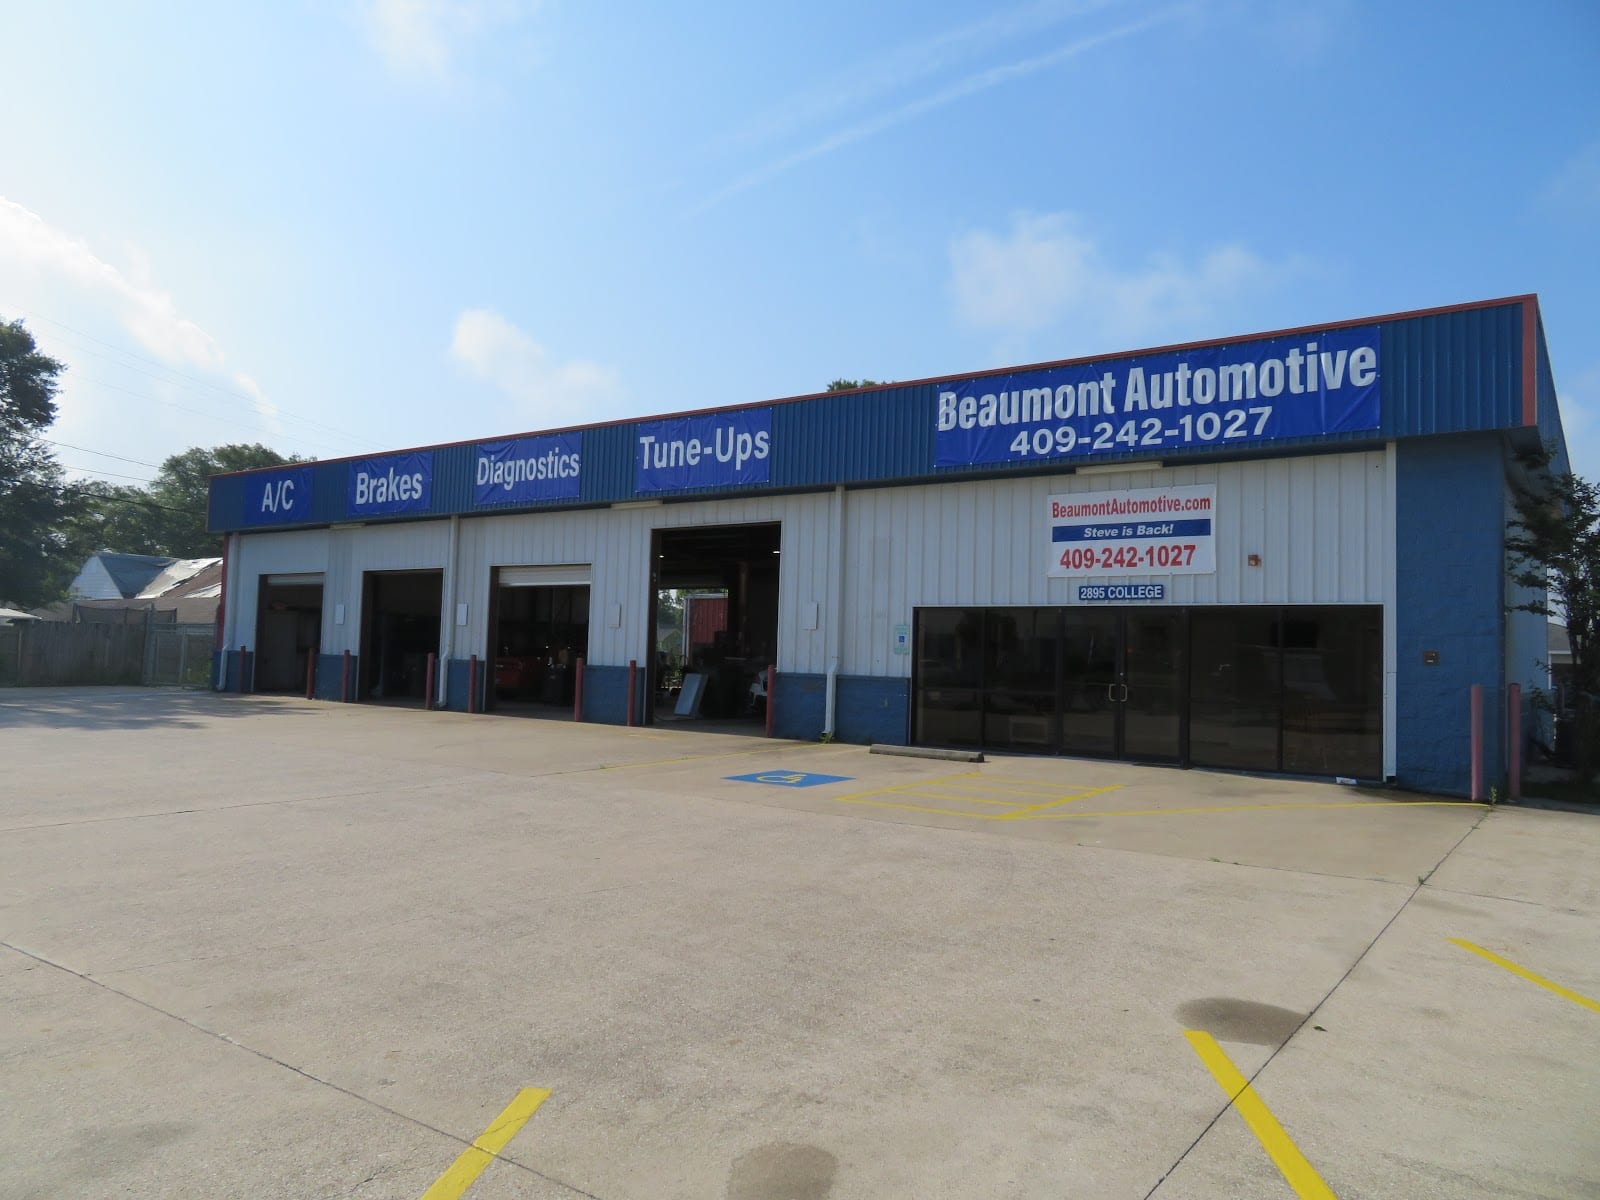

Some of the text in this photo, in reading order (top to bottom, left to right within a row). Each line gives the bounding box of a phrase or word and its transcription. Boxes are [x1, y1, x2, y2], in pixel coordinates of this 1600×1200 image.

[937, 342, 1377, 431] Beaumont Automotive
[639, 427, 770, 470] Tune-Ups
[1009, 406, 1273, 456] 409-242-1027
[356, 467, 423, 505] Brakes
[476, 447, 580, 491] Diagnostics
[261, 479, 294, 512] A/C
[1051, 496, 1211, 519] BeaumontAutomotive.com
[1084, 524, 1174, 538] Steve is Back!
[1060, 545, 1196, 570] 409-242-1027
[1080, 586, 1162, 599] 2895 COLLEGE
